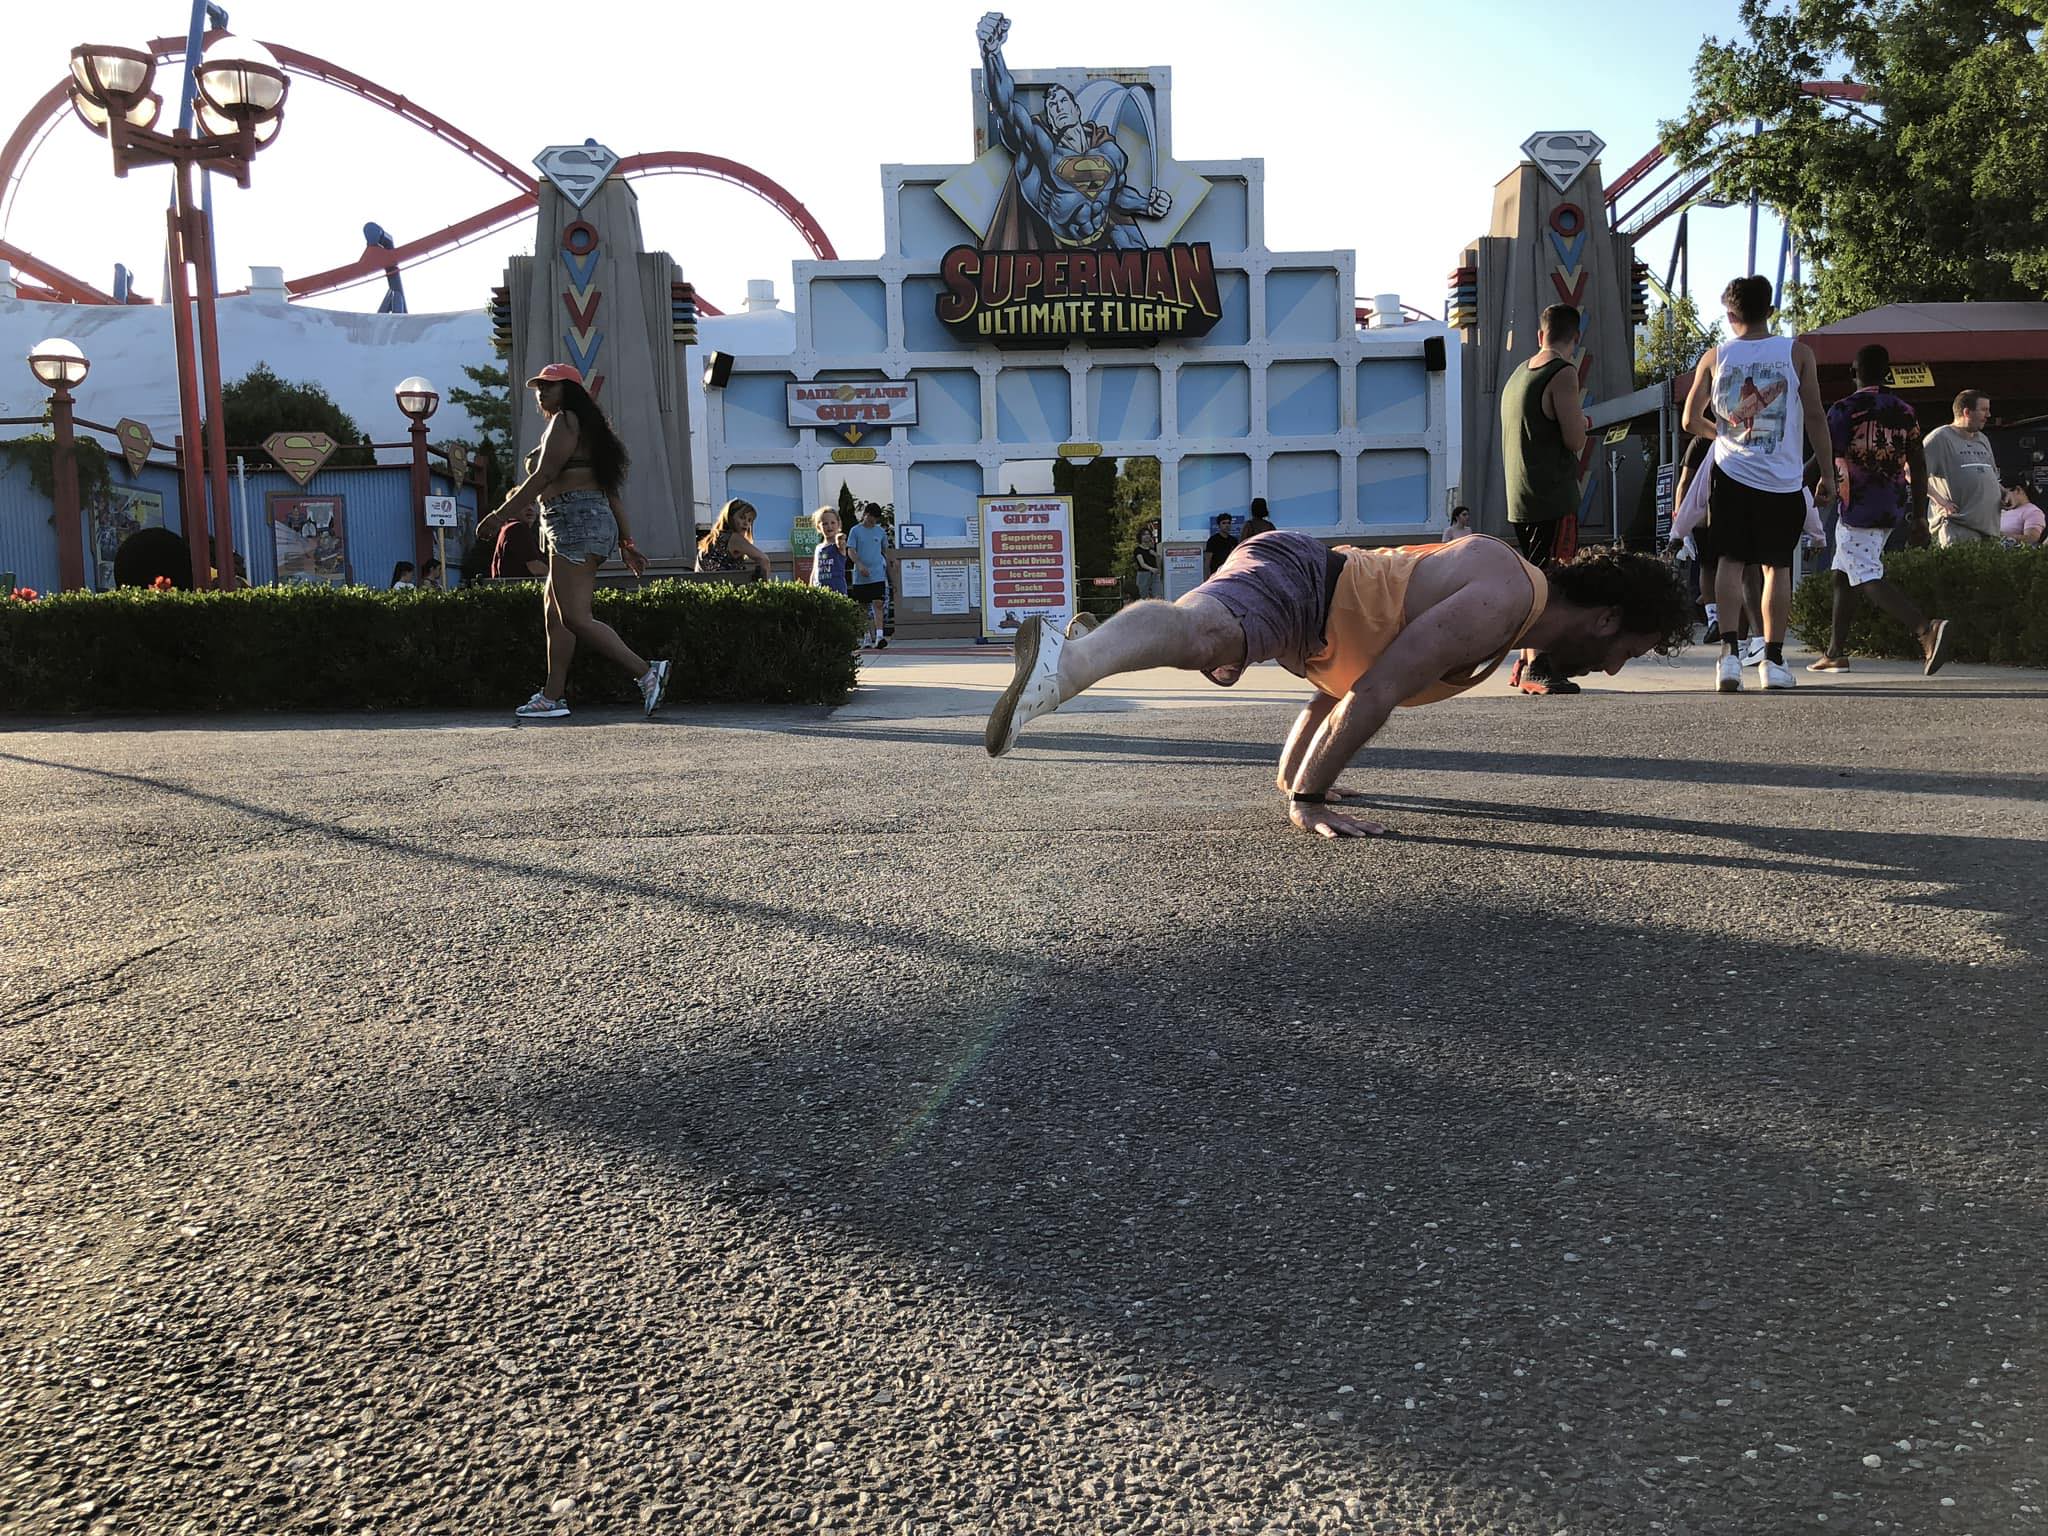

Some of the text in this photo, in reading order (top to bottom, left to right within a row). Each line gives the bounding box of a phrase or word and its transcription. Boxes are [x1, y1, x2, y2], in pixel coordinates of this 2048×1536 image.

[939, 245, 1219, 323] SUPERMAN
[978, 301, 1188, 334] ULTIMATE FLIGHT
[796, 387, 908, 400] DAILY PLANET
[816, 404, 891, 420] GIFTS
[1003, 514, 1050, 524] GIFTS
[1000, 534, 1054, 542] Superhero
[1002, 543, 1053, 551] Souvenirs
[1013, 557, 1030, 565] Cold
[1014, 584, 1043, 592] Snacks
